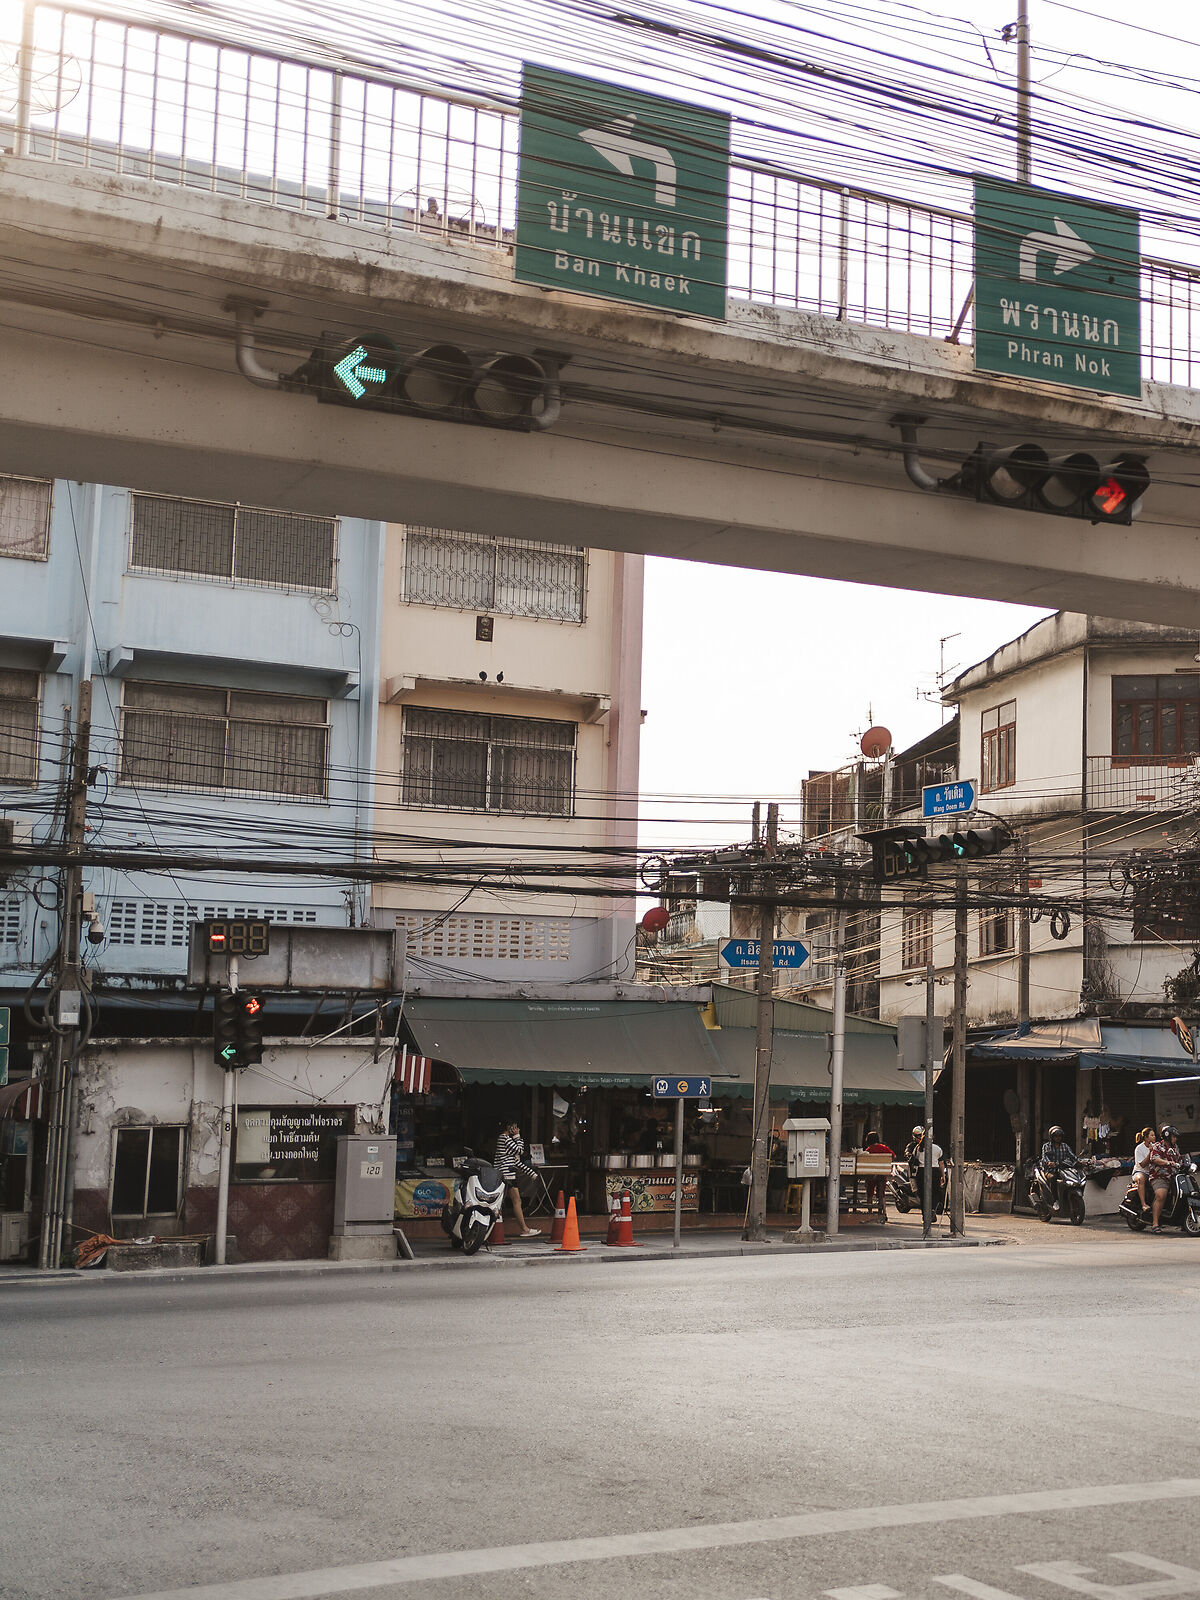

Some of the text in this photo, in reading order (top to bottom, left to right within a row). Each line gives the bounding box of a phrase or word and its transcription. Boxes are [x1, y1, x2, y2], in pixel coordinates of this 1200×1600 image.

[546, 190, 701, 261] บ้านแขก
[554, 248, 690, 295] Ban Khaek
[999, 298, 1119, 346] พรานนก
[1008, 341, 1111, 377] Phran Nok
[943, 785, 964, 801] วังเดิม
[933, 805, 945, 813] Wang
[735, 945, 745, 955] ถ.
[225, 1123, 231, 1132] 8
[279, 1130, 320, 1143] โพธิ์สามต้น
[366, 1166, 381, 1175] 120
